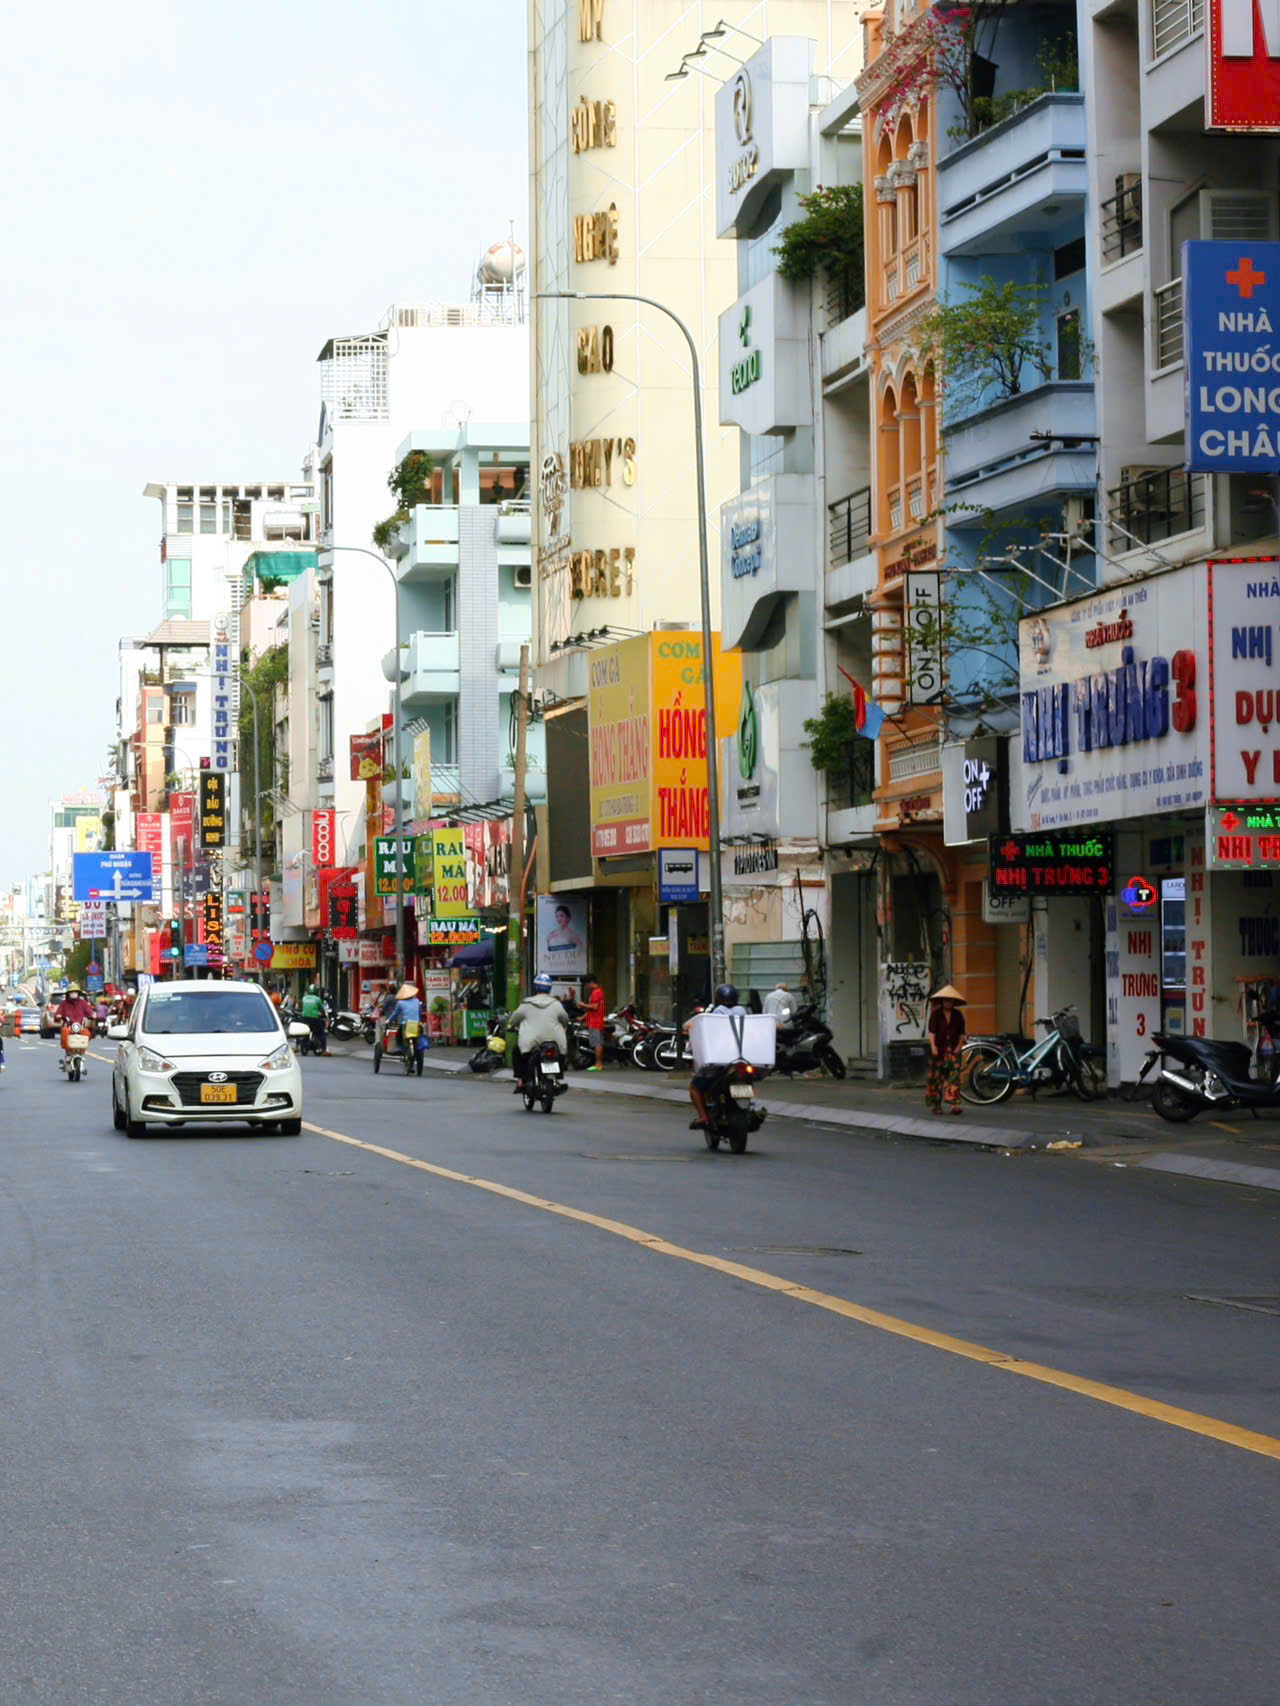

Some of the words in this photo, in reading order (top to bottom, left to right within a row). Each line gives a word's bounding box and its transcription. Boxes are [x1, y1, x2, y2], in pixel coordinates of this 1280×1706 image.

[1218, 307, 1273, 333] NHÀ
[577, 325, 614, 376] CAO
[1232, 624, 1272, 667] NHỊ
[215, 645, 228, 690] NHỊ
[918, 658, 935, 690] ON
[658, 691, 708, 760] HỒNG
[1023, 683, 1069, 774] NHỊ
[1071, 646, 1169, 752] TRƯNG
[1172, 650, 1196, 733] 3
[215, 695, 229, 768] TRƯNG
[964, 759, 978, 784] ON
[964, 787, 982, 813] OFF
[1026, 841, 1054, 857] NHÀ
[1059, 839, 1104, 857] THUỐC
[996, 867, 1027, 890] NHỊ
[1098, 867, 1109, 886] 3
[207, 893, 220, 943] LISA
[1128, 931, 1152, 959] NHỊ
[1122, 971, 1158, 997] TRƯNG
[1191, 940, 1206, 1038] TRƯN
[1136, 1013, 1146, 1037] 3
